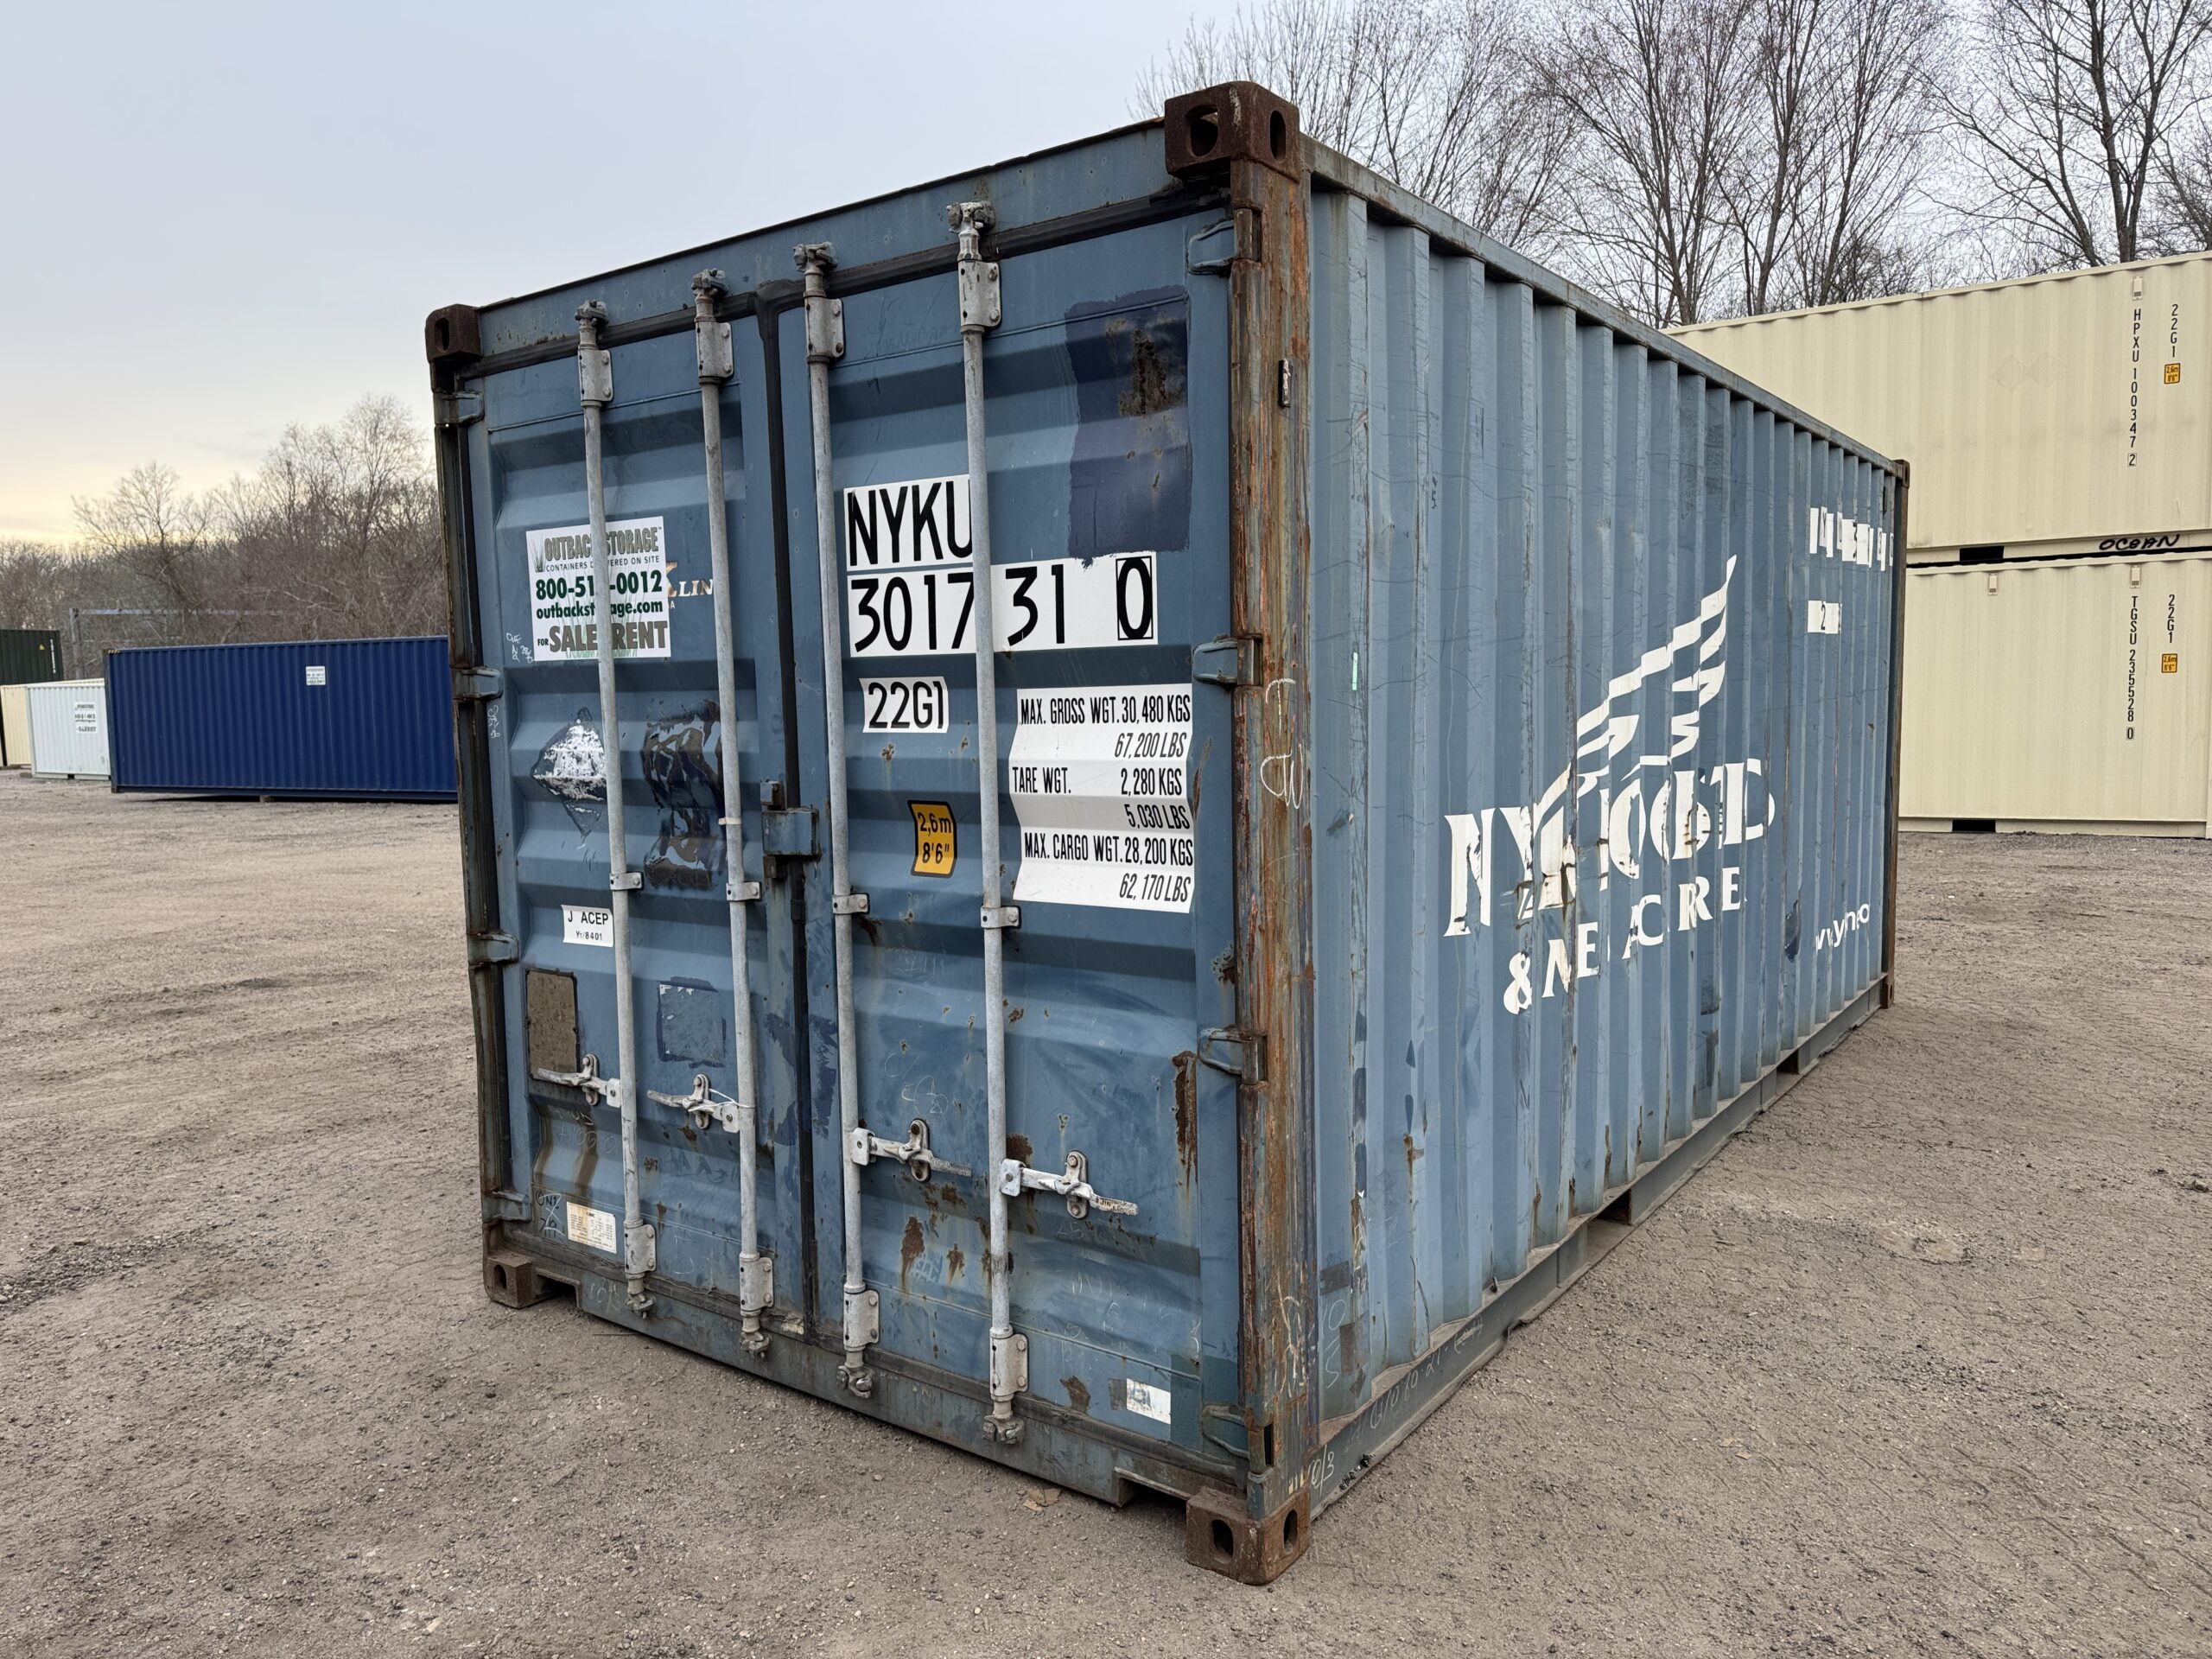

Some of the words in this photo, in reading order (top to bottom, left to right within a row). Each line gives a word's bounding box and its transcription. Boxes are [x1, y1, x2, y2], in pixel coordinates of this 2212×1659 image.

[2132, 308, 2141, 362] HPXU
[2170, 304, 2179, 358] 22G1
[2128, 454, 2136, 467] 2
[847, 480, 972, 567] NYKU
[544, 534, 592, 562] OUTBAC
[546, 562, 588, 572] CONTAINERS
[631, 556, 642, 565] ON
[536, 569, 663, 601] 800-51-0012
[678, 578, 714, 597] LIN
[1116, 556, 1154, 640] 0
[536, 601, 664, 620] outbackstage.com
[2129, 595, 2139, 645] TGSU
[2166, 594, 2176, 644] 22G1
[537, 638, 549, 646] FOR
[549, 624, 598, 652] SALE
[612, 620, 668, 650] RENT
[2127, 649, 2136, 722] 235528
[868, 680, 944, 729] 22G1
[1020, 698, 1046, 725] MAX.
[1050, 698, 1085, 724] GROSS
[1090, 696, 1120, 724] WGT.
[1122, 695, 1164, 724] 30,480
[1166, 695, 1191, 722] KGS
[1115, 733, 1160, 759] 67,200
[1160, 733, 1187, 758] LBS
[2126, 728, 2134, 740] 0
[1012, 766, 1038, 793] TARE
[1043, 767, 1071, 794] WGT.
[1121, 767, 1155, 796] 2,280
[1159, 768, 1183, 796] KGS
[917, 811, 952, 836] 2,6m
[1123, 804, 1163, 830] 5,030
[1162, 804, 1191, 830] LBS
[922, 842, 950, 864] 8'6"
[1024, 832, 1050, 859] MAX.
[1052, 834, 1089, 861] CARGO
[1093, 836, 1123, 862] WGT.
[1124, 836, 1166, 865] 28,200
[1170, 838, 1193, 866] KGS
[1119, 873, 1165, 900] 62,170
[1164, 875, 1192, 902] LBS
[568, 910, 573, 923] J
[581, 911, 609, 925] ACEP
